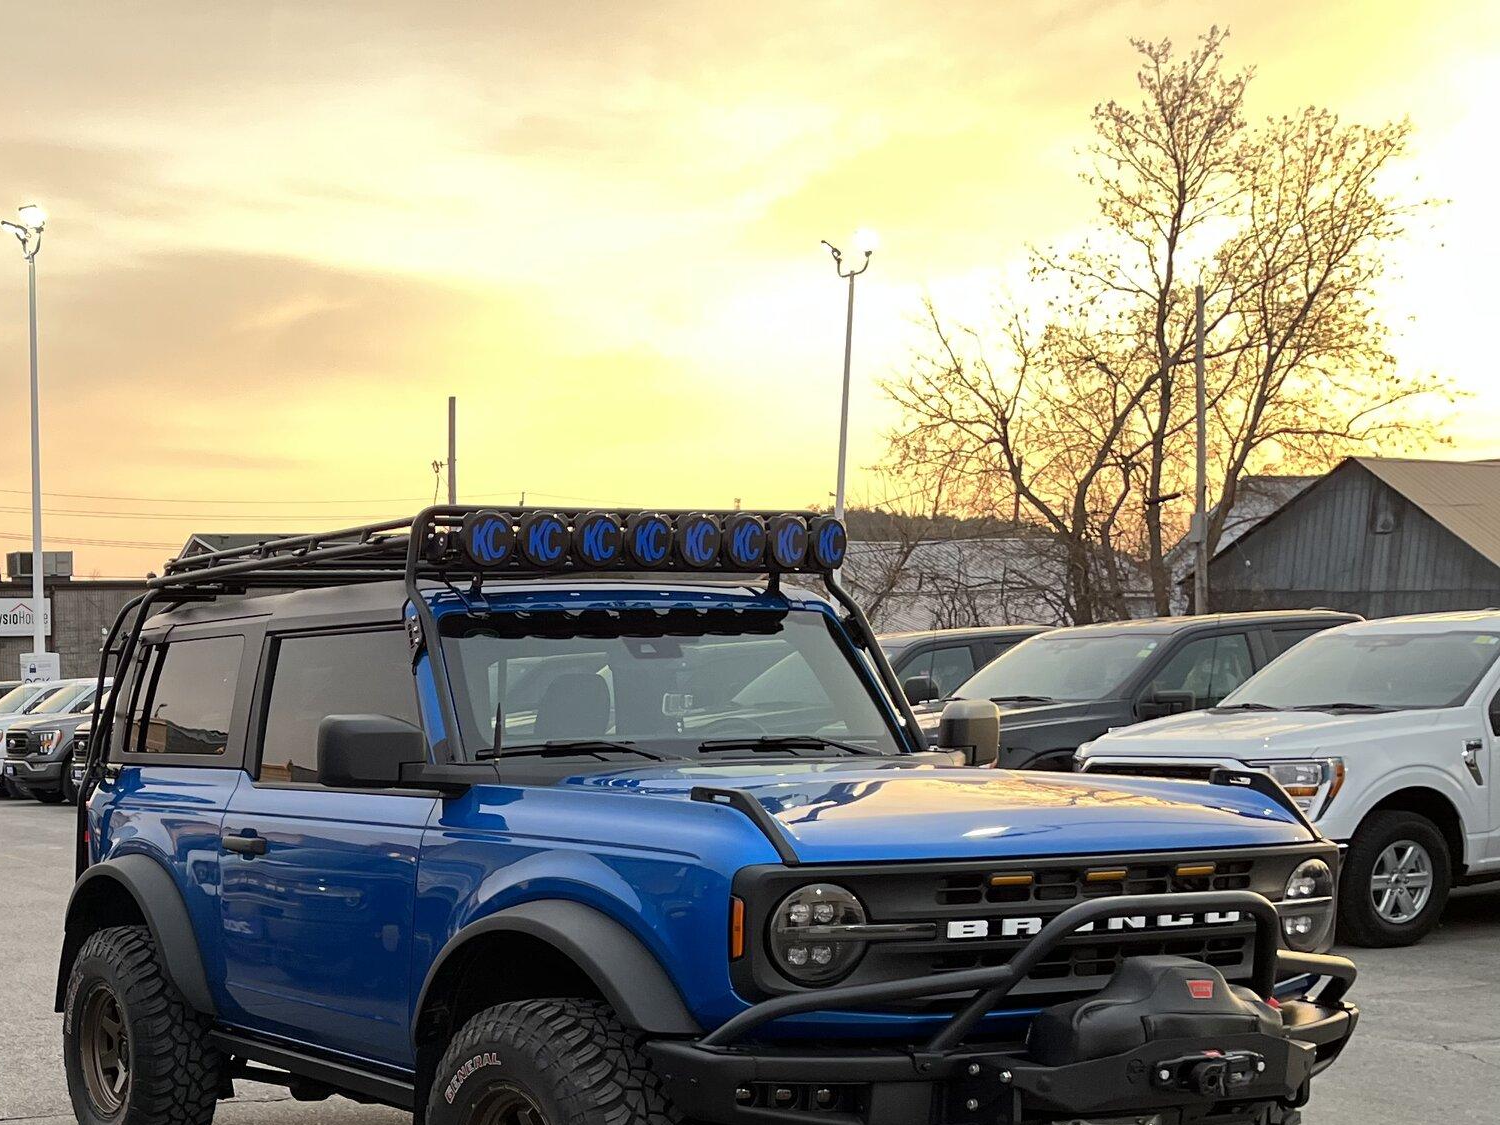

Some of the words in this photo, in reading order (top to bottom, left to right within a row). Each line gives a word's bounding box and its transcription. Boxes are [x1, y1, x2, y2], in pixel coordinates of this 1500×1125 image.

[472, 518, 506, 561] KC
[529, 518, 562, 561] KC
[584, 518, 616, 561] KC
[636, 519, 666, 562] KC
[685, 520, 715, 563] KC
[733, 521, 761, 563] KC
[777, 522, 803, 563] KC
[819, 523, 843, 563] KC
[444, 1052, 502, 1104] GENERAL
